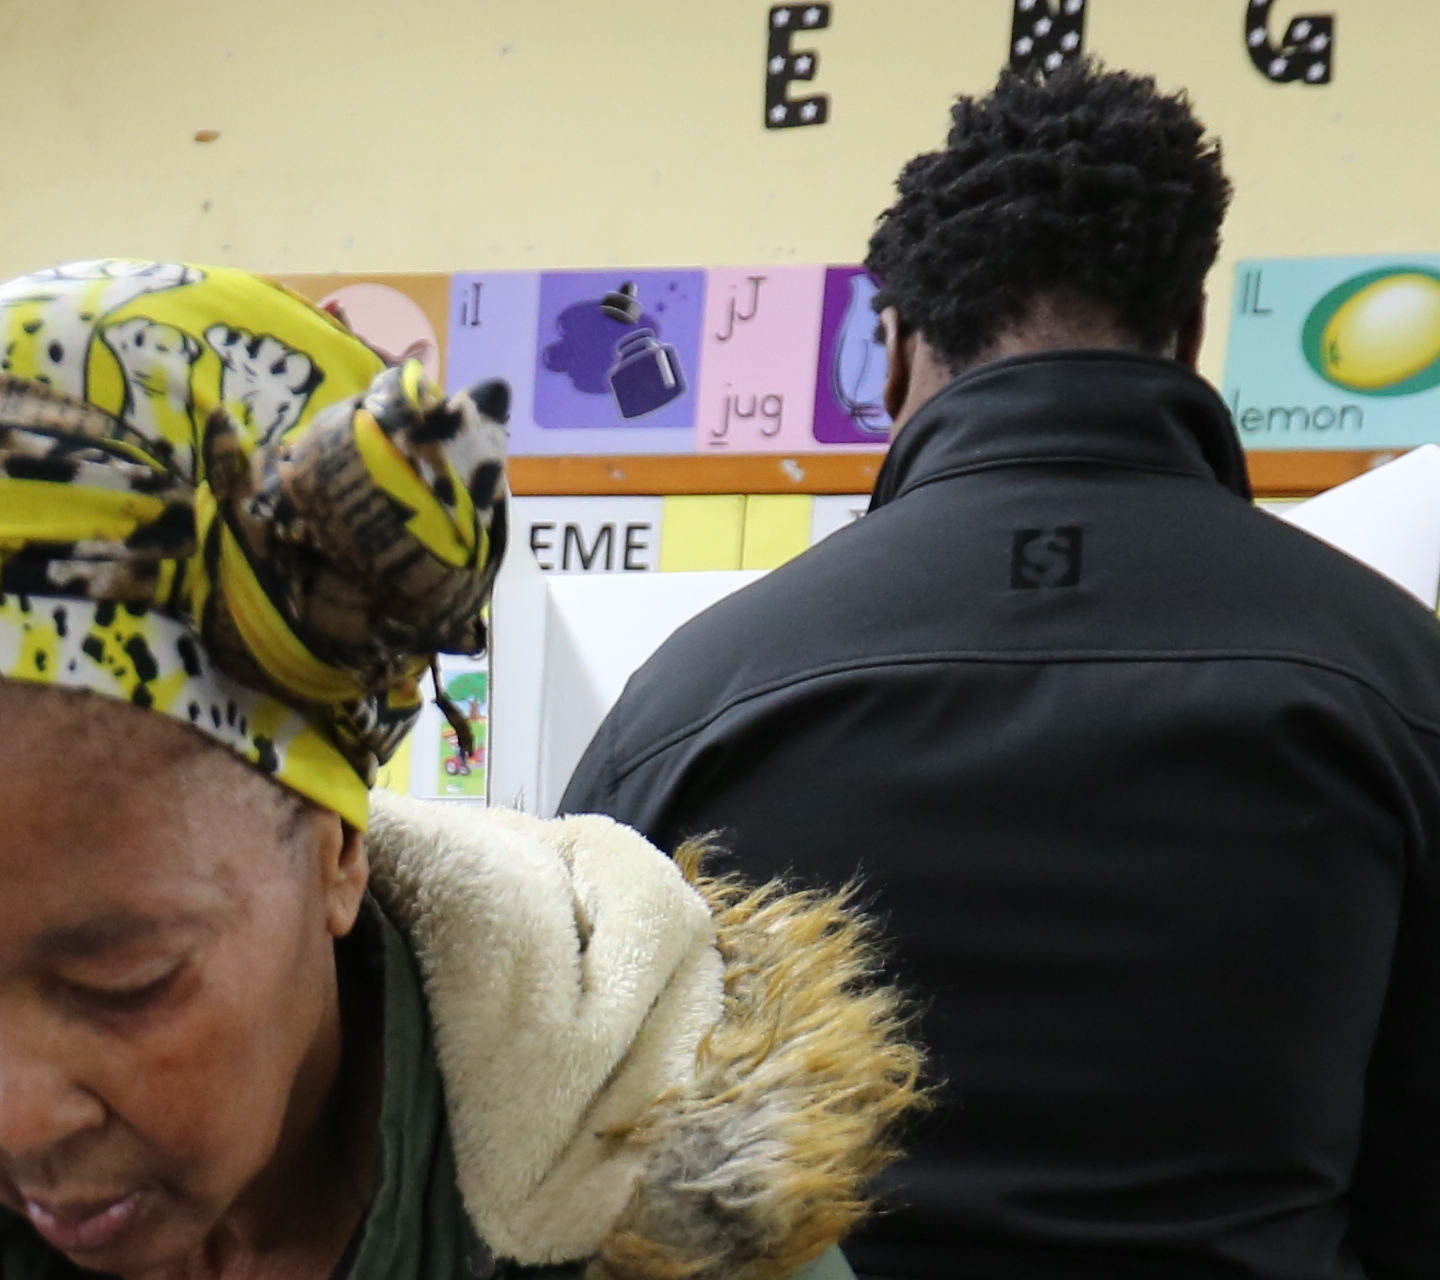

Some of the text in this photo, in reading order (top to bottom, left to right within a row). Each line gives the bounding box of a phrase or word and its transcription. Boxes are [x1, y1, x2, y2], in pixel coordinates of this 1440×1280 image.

[715, 277, 767, 341] jJ
[710, 383, 784, 440] jug
[1231, 388, 1364, 434] lemon
